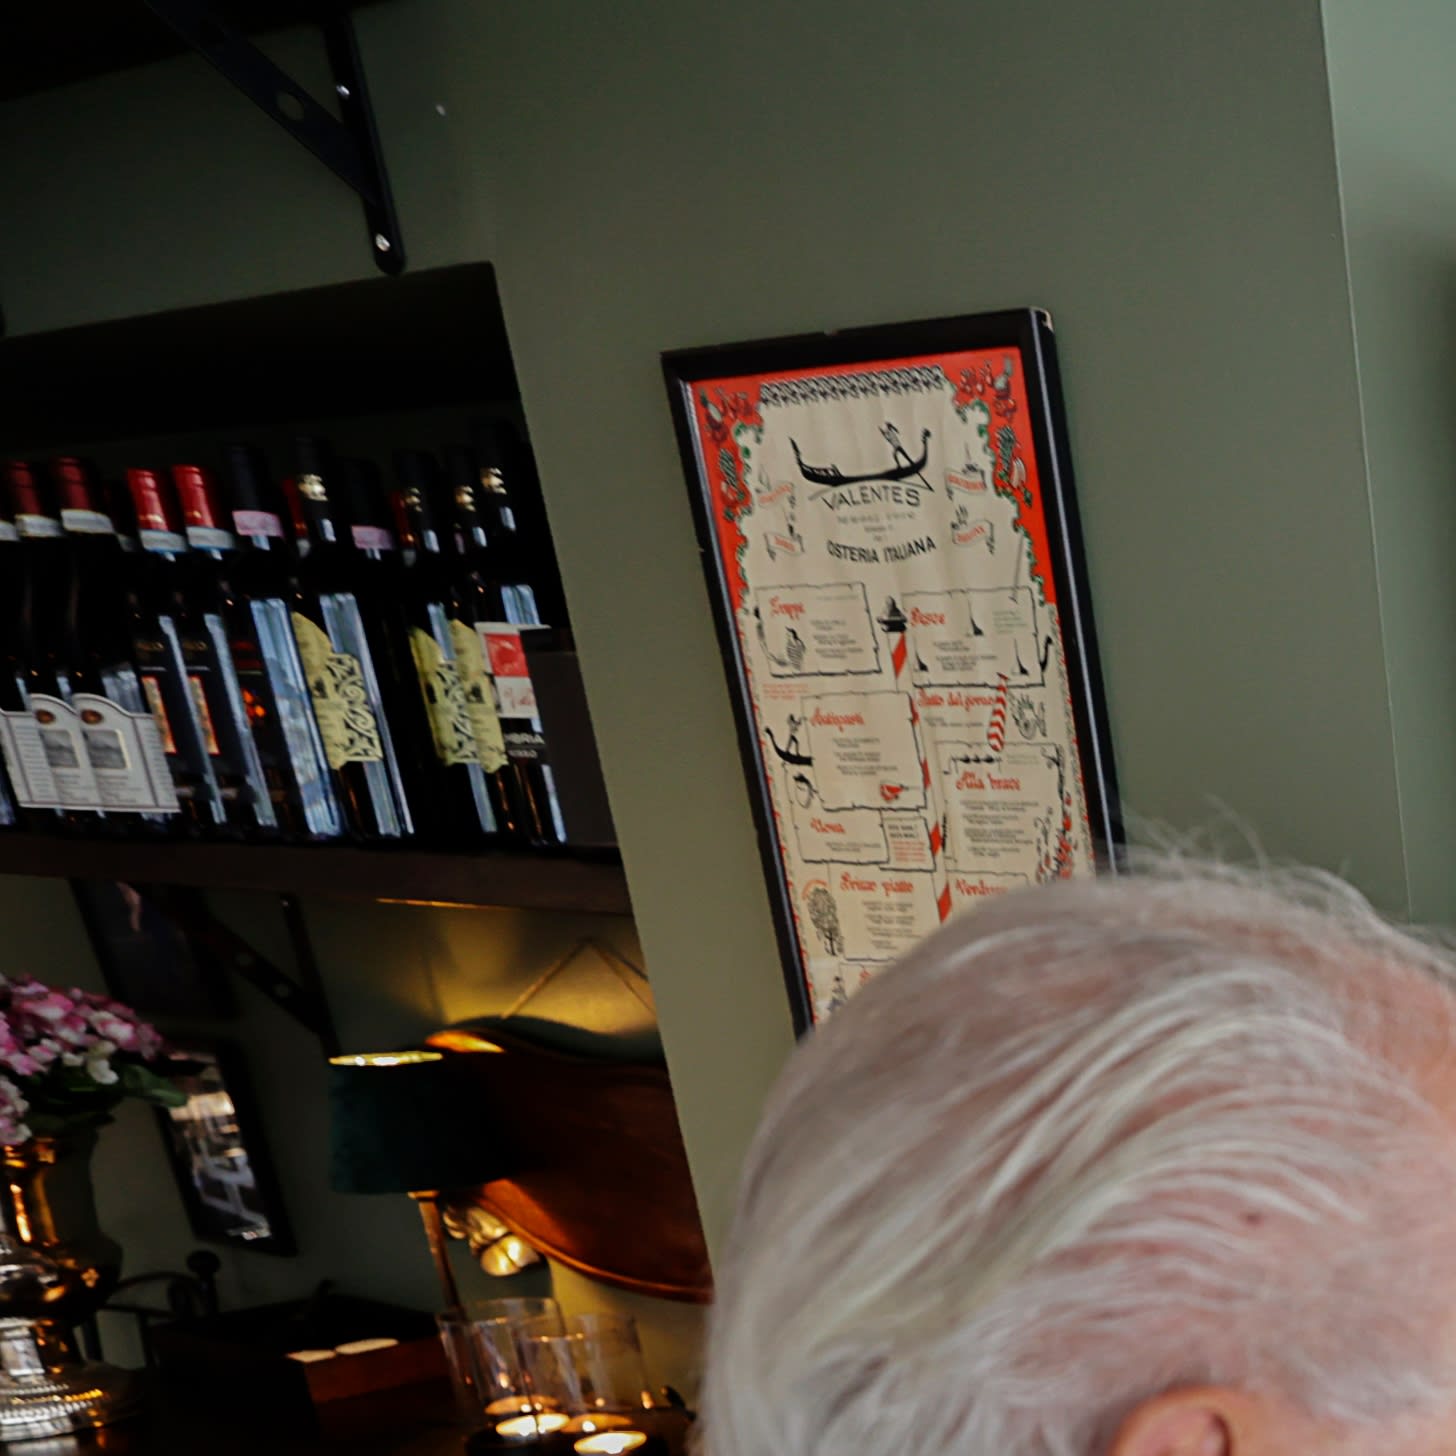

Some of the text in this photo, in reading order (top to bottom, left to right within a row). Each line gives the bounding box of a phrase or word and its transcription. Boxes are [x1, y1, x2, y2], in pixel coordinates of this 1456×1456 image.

[822, 485, 921, 511] VALENTES
[827, 539, 880, 563] OSTERIA
[884, 535, 937, 563] ITALIANA
